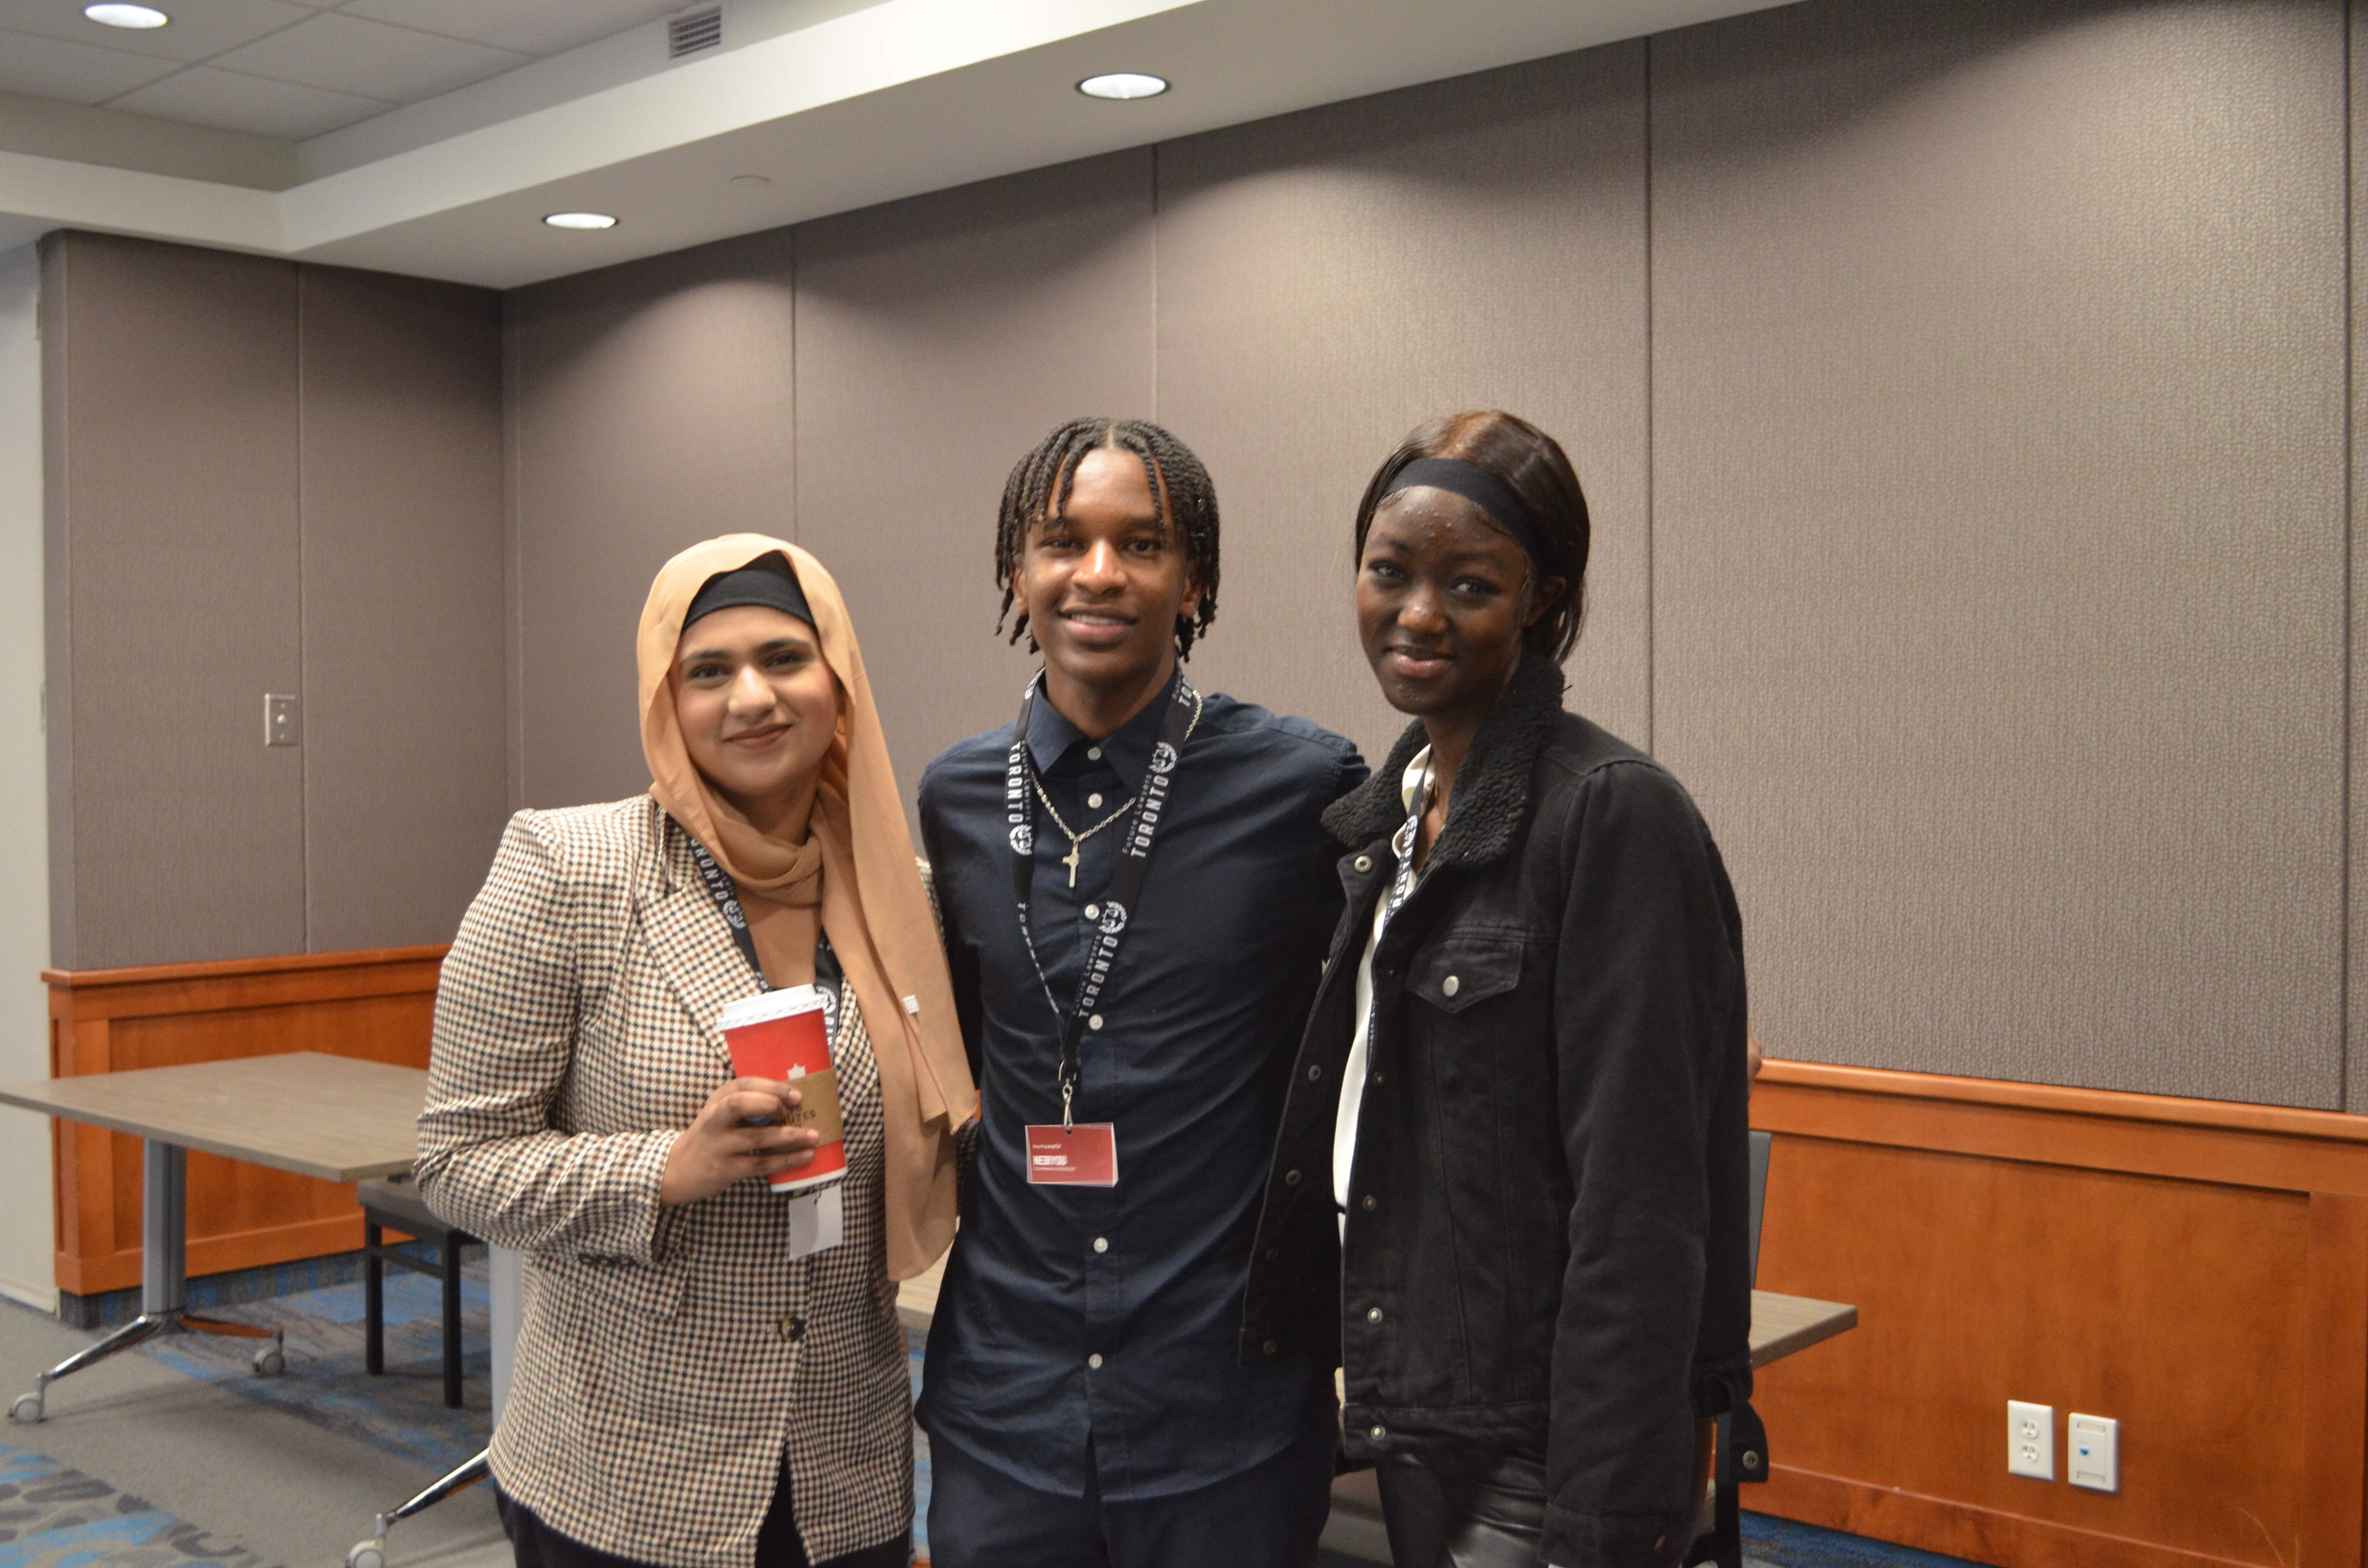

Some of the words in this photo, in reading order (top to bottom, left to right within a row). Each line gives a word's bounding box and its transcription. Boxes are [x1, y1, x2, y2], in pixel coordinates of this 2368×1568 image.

[1008, 740, 1024, 823] TORONTO
[1131, 774, 1169, 858] TORONTO
[691, 839, 729, 901] RONTO
[1390, 846, 1413, 917] RONTO
[1078, 935, 1119, 1017] TORONTO
